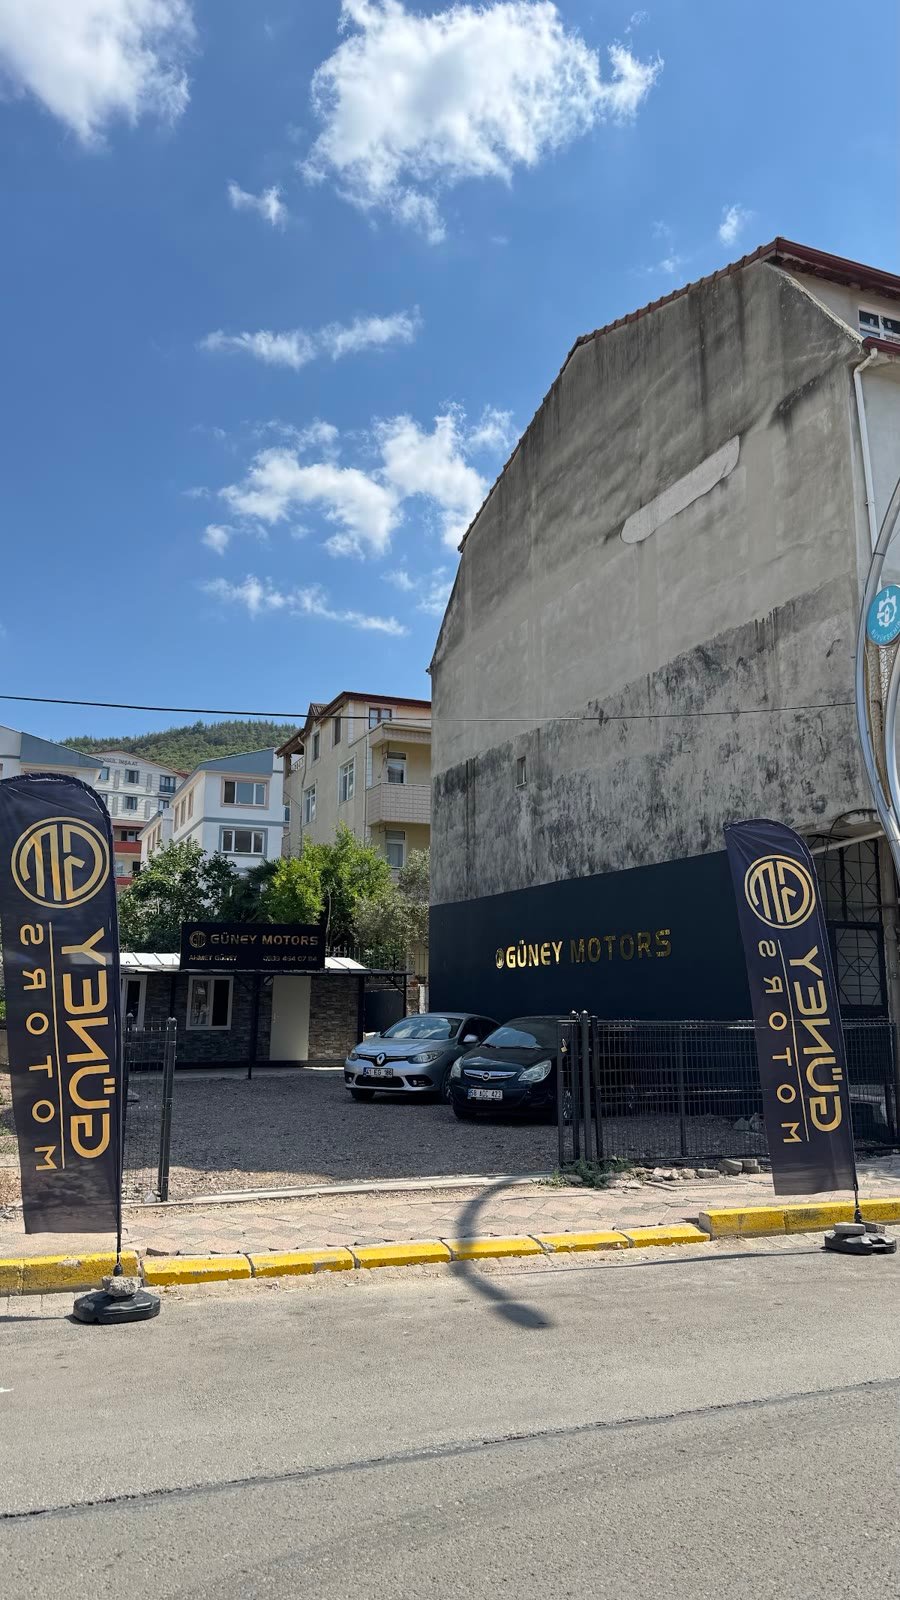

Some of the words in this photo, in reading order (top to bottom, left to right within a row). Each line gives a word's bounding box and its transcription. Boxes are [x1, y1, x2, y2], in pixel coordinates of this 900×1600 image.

[210, 931, 258, 945] GÜNEY
[261, 934, 319, 946] MOTORS
[505, 939, 563, 969] GÜNEY
[570, 929, 672, 964] MOTORS
[214, 953, 238, 962] GÜNEY
